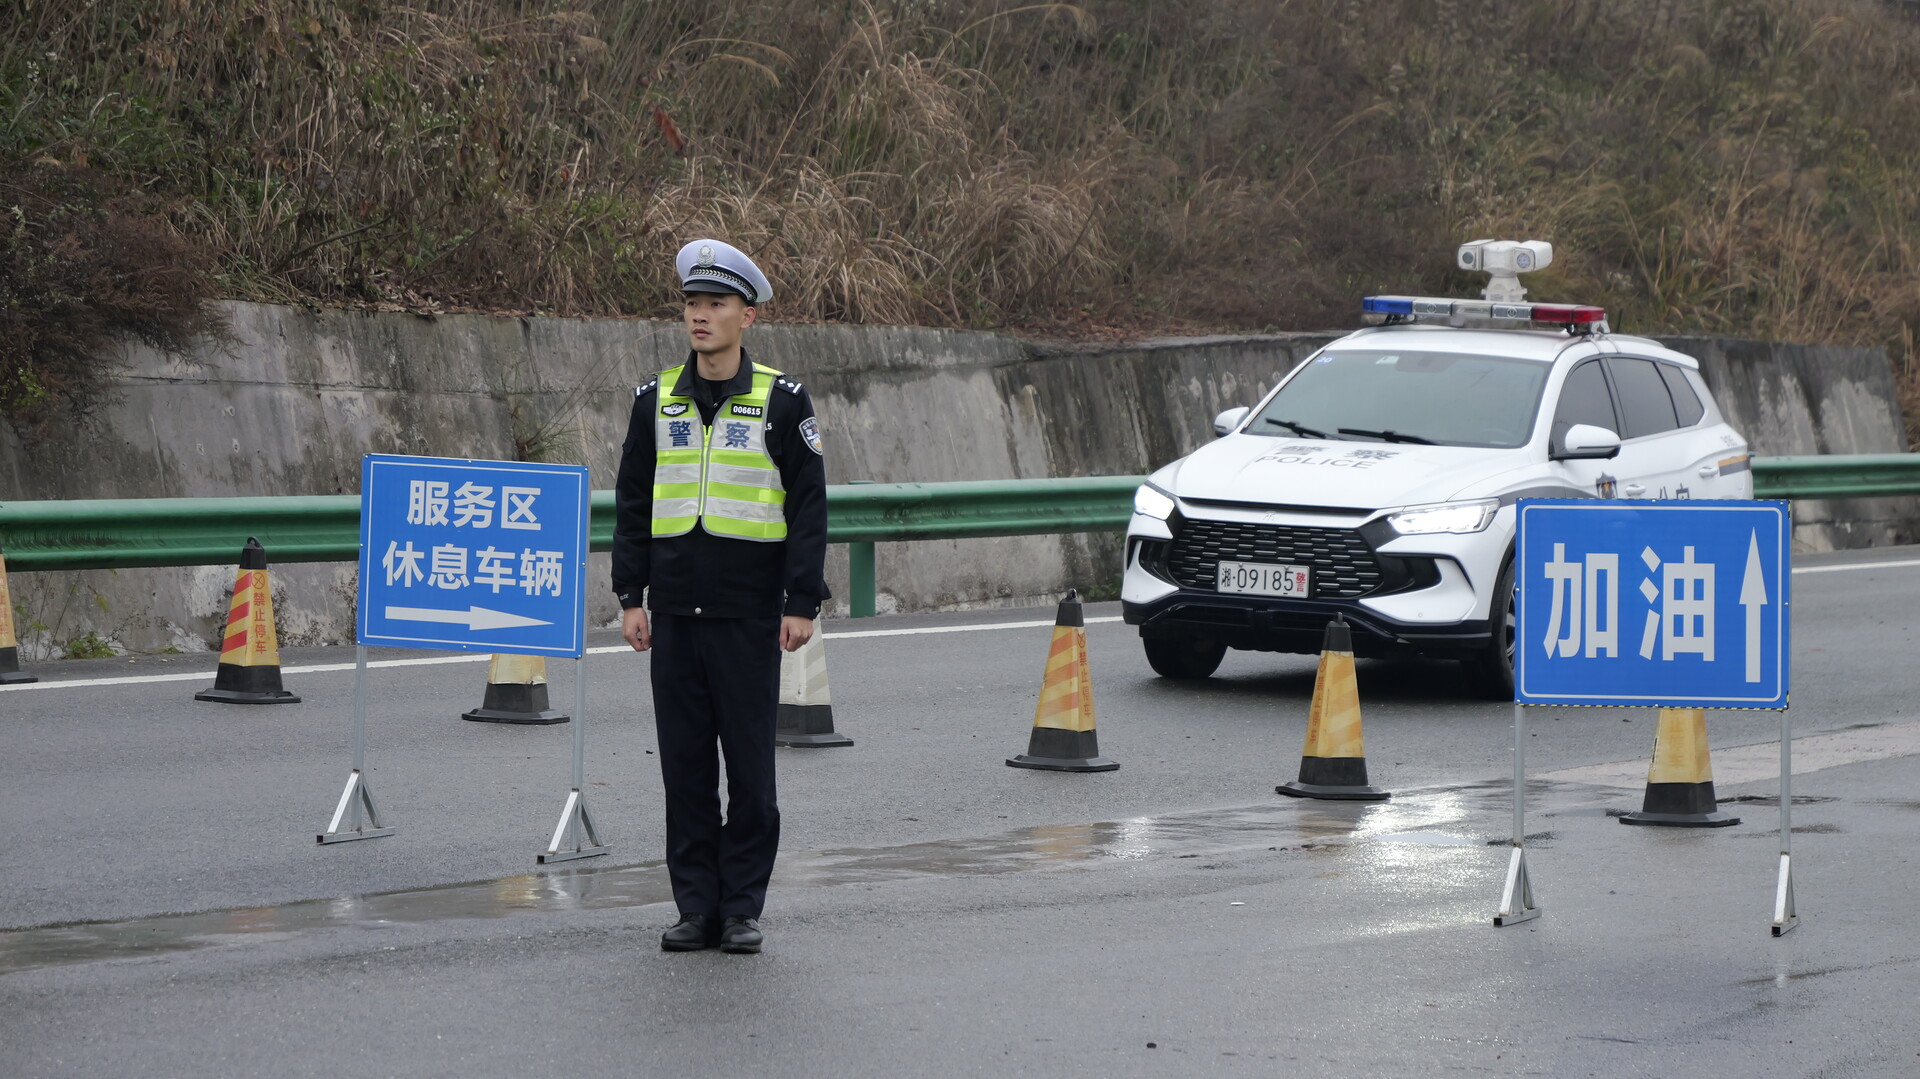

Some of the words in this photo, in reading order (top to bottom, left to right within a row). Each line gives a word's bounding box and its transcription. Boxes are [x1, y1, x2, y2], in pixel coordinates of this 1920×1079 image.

[668, 421, 751, 449] 警察
[733, 405, 761, 416] 006615
[1255, 455, 1377, 469] POLICE
[406, 480, 542, 530] 服务区
[382, 540, 564, 597] 休息车辆
[253, 592, 268, 654] 禁止停车
[1543, 542, 1715, 662] 加油
